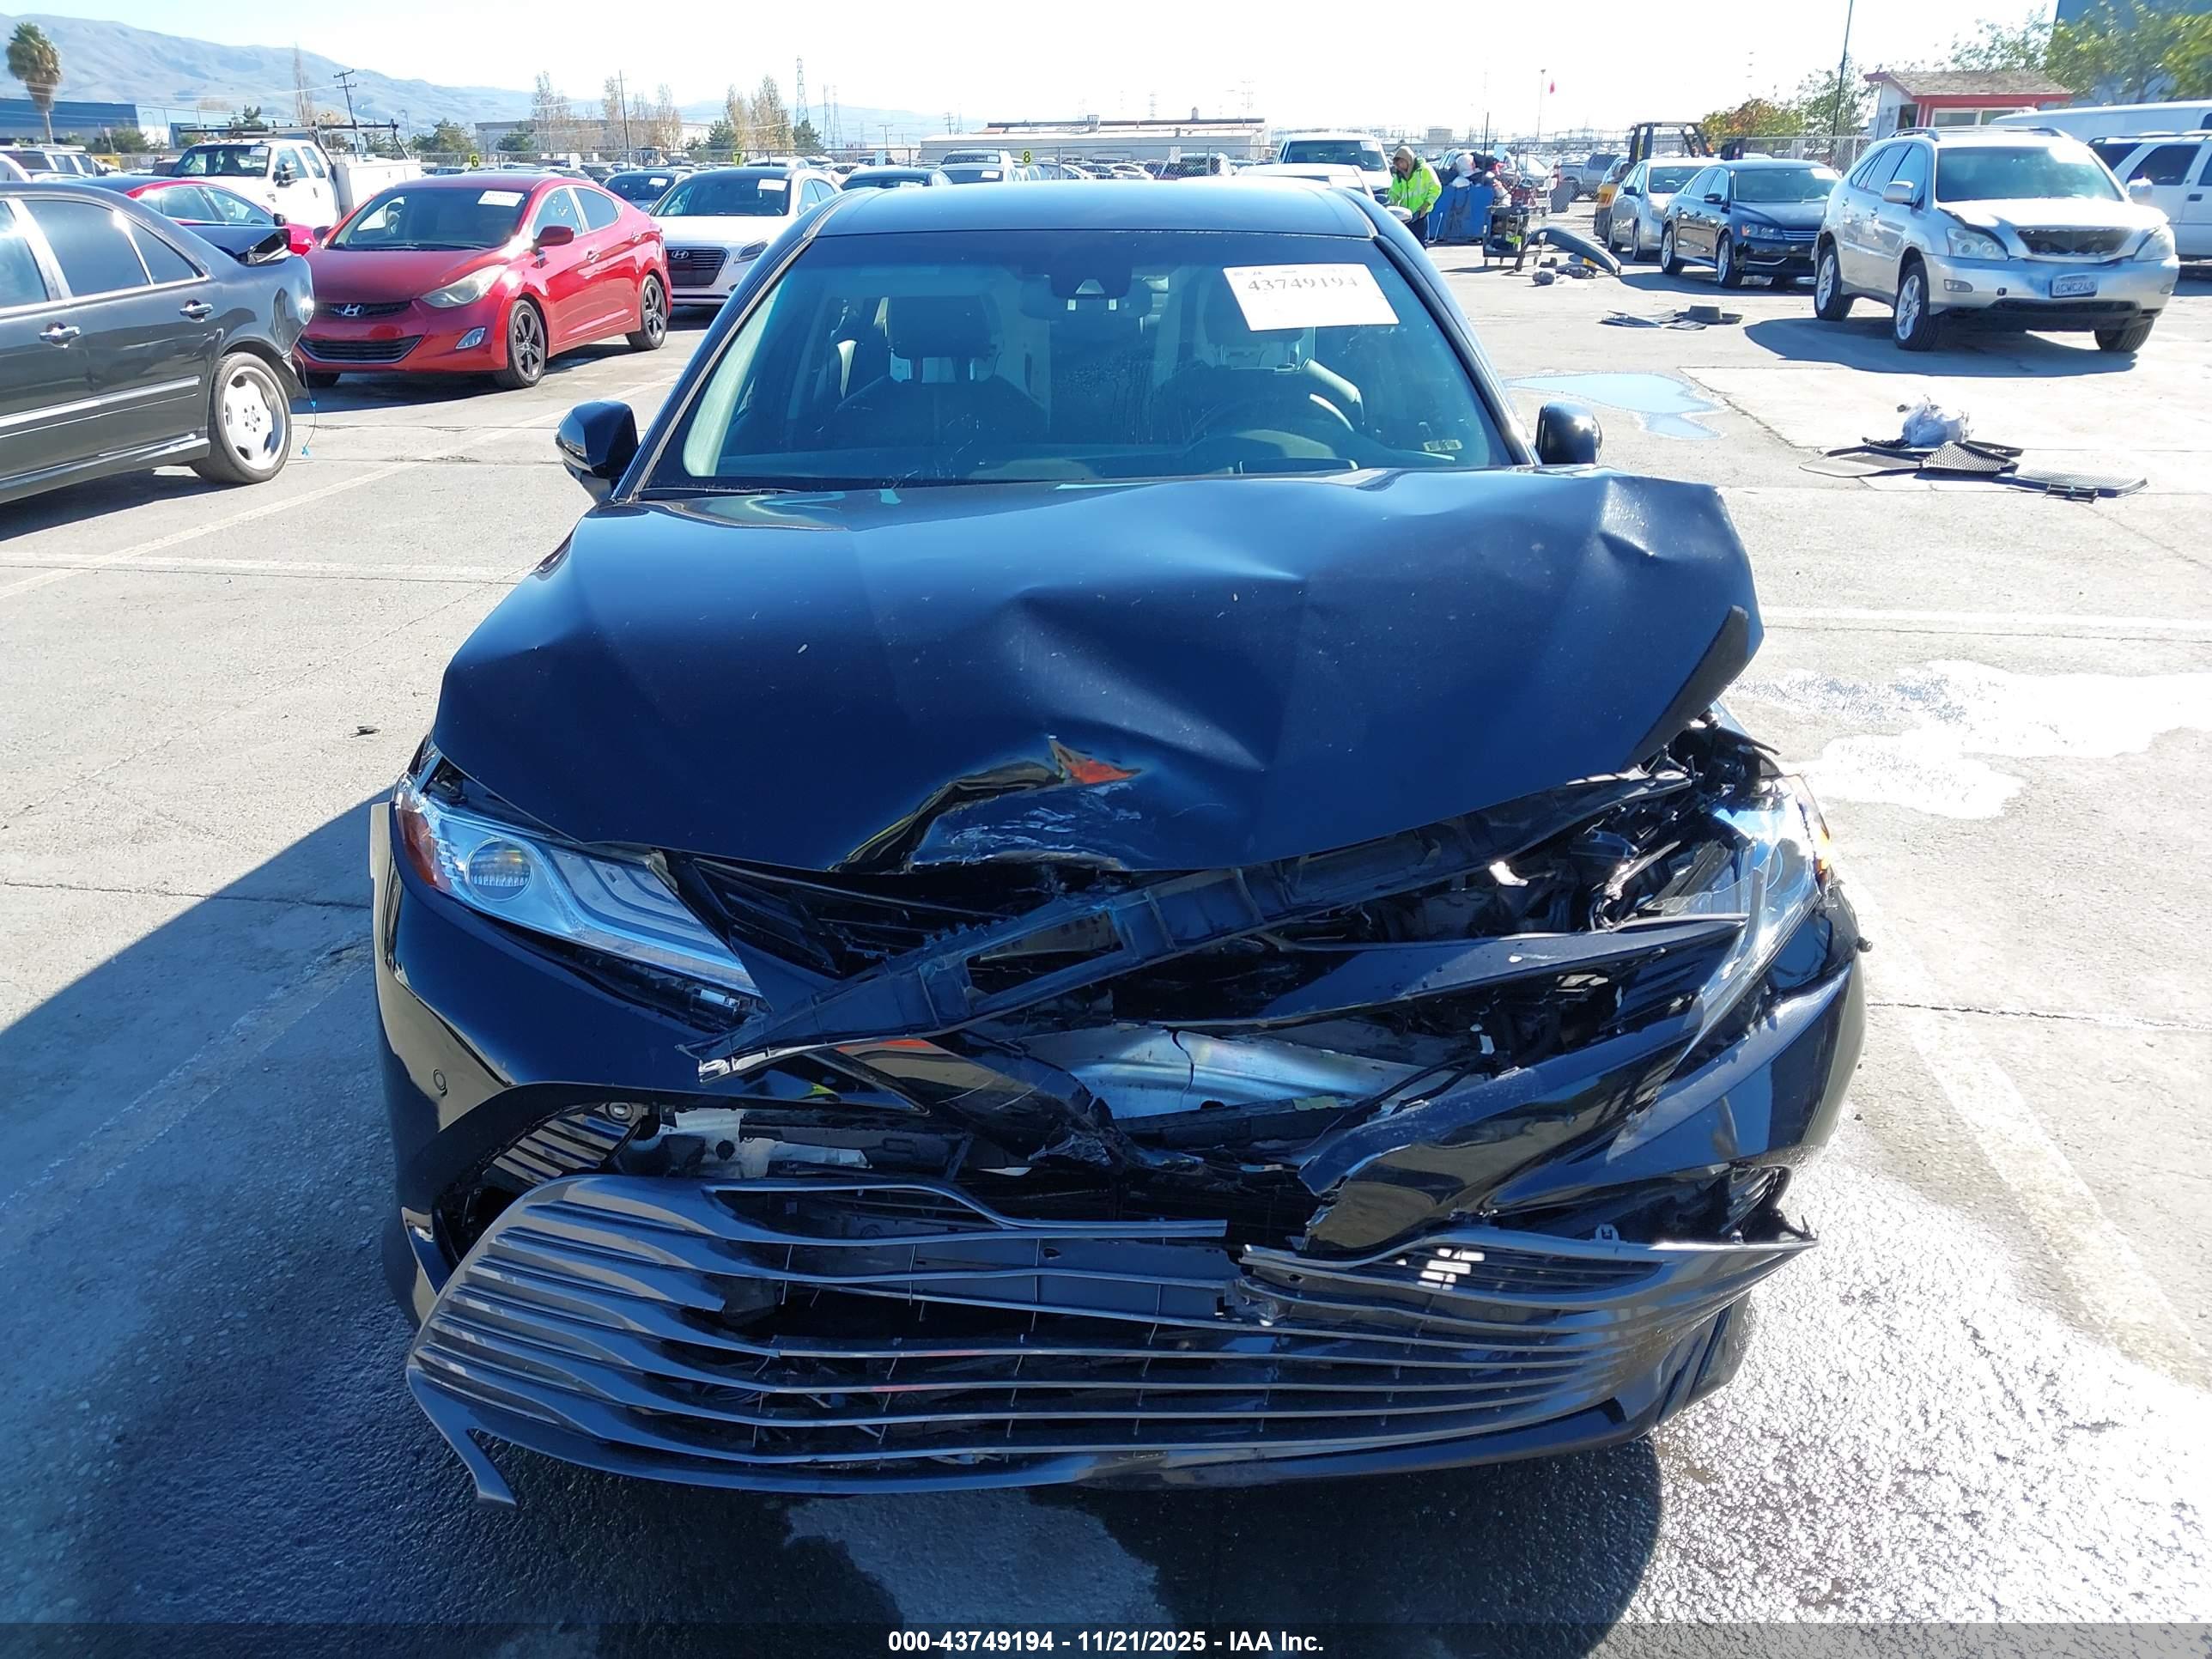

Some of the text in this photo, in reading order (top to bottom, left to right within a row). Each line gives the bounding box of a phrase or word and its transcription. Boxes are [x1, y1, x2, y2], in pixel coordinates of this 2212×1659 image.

[471, 155, 479, 167] 6
[733, 153, 741, 166] 7
[1023, 150, 1031, 163] 8
[1248, 276, 1358, 291] 43749194
